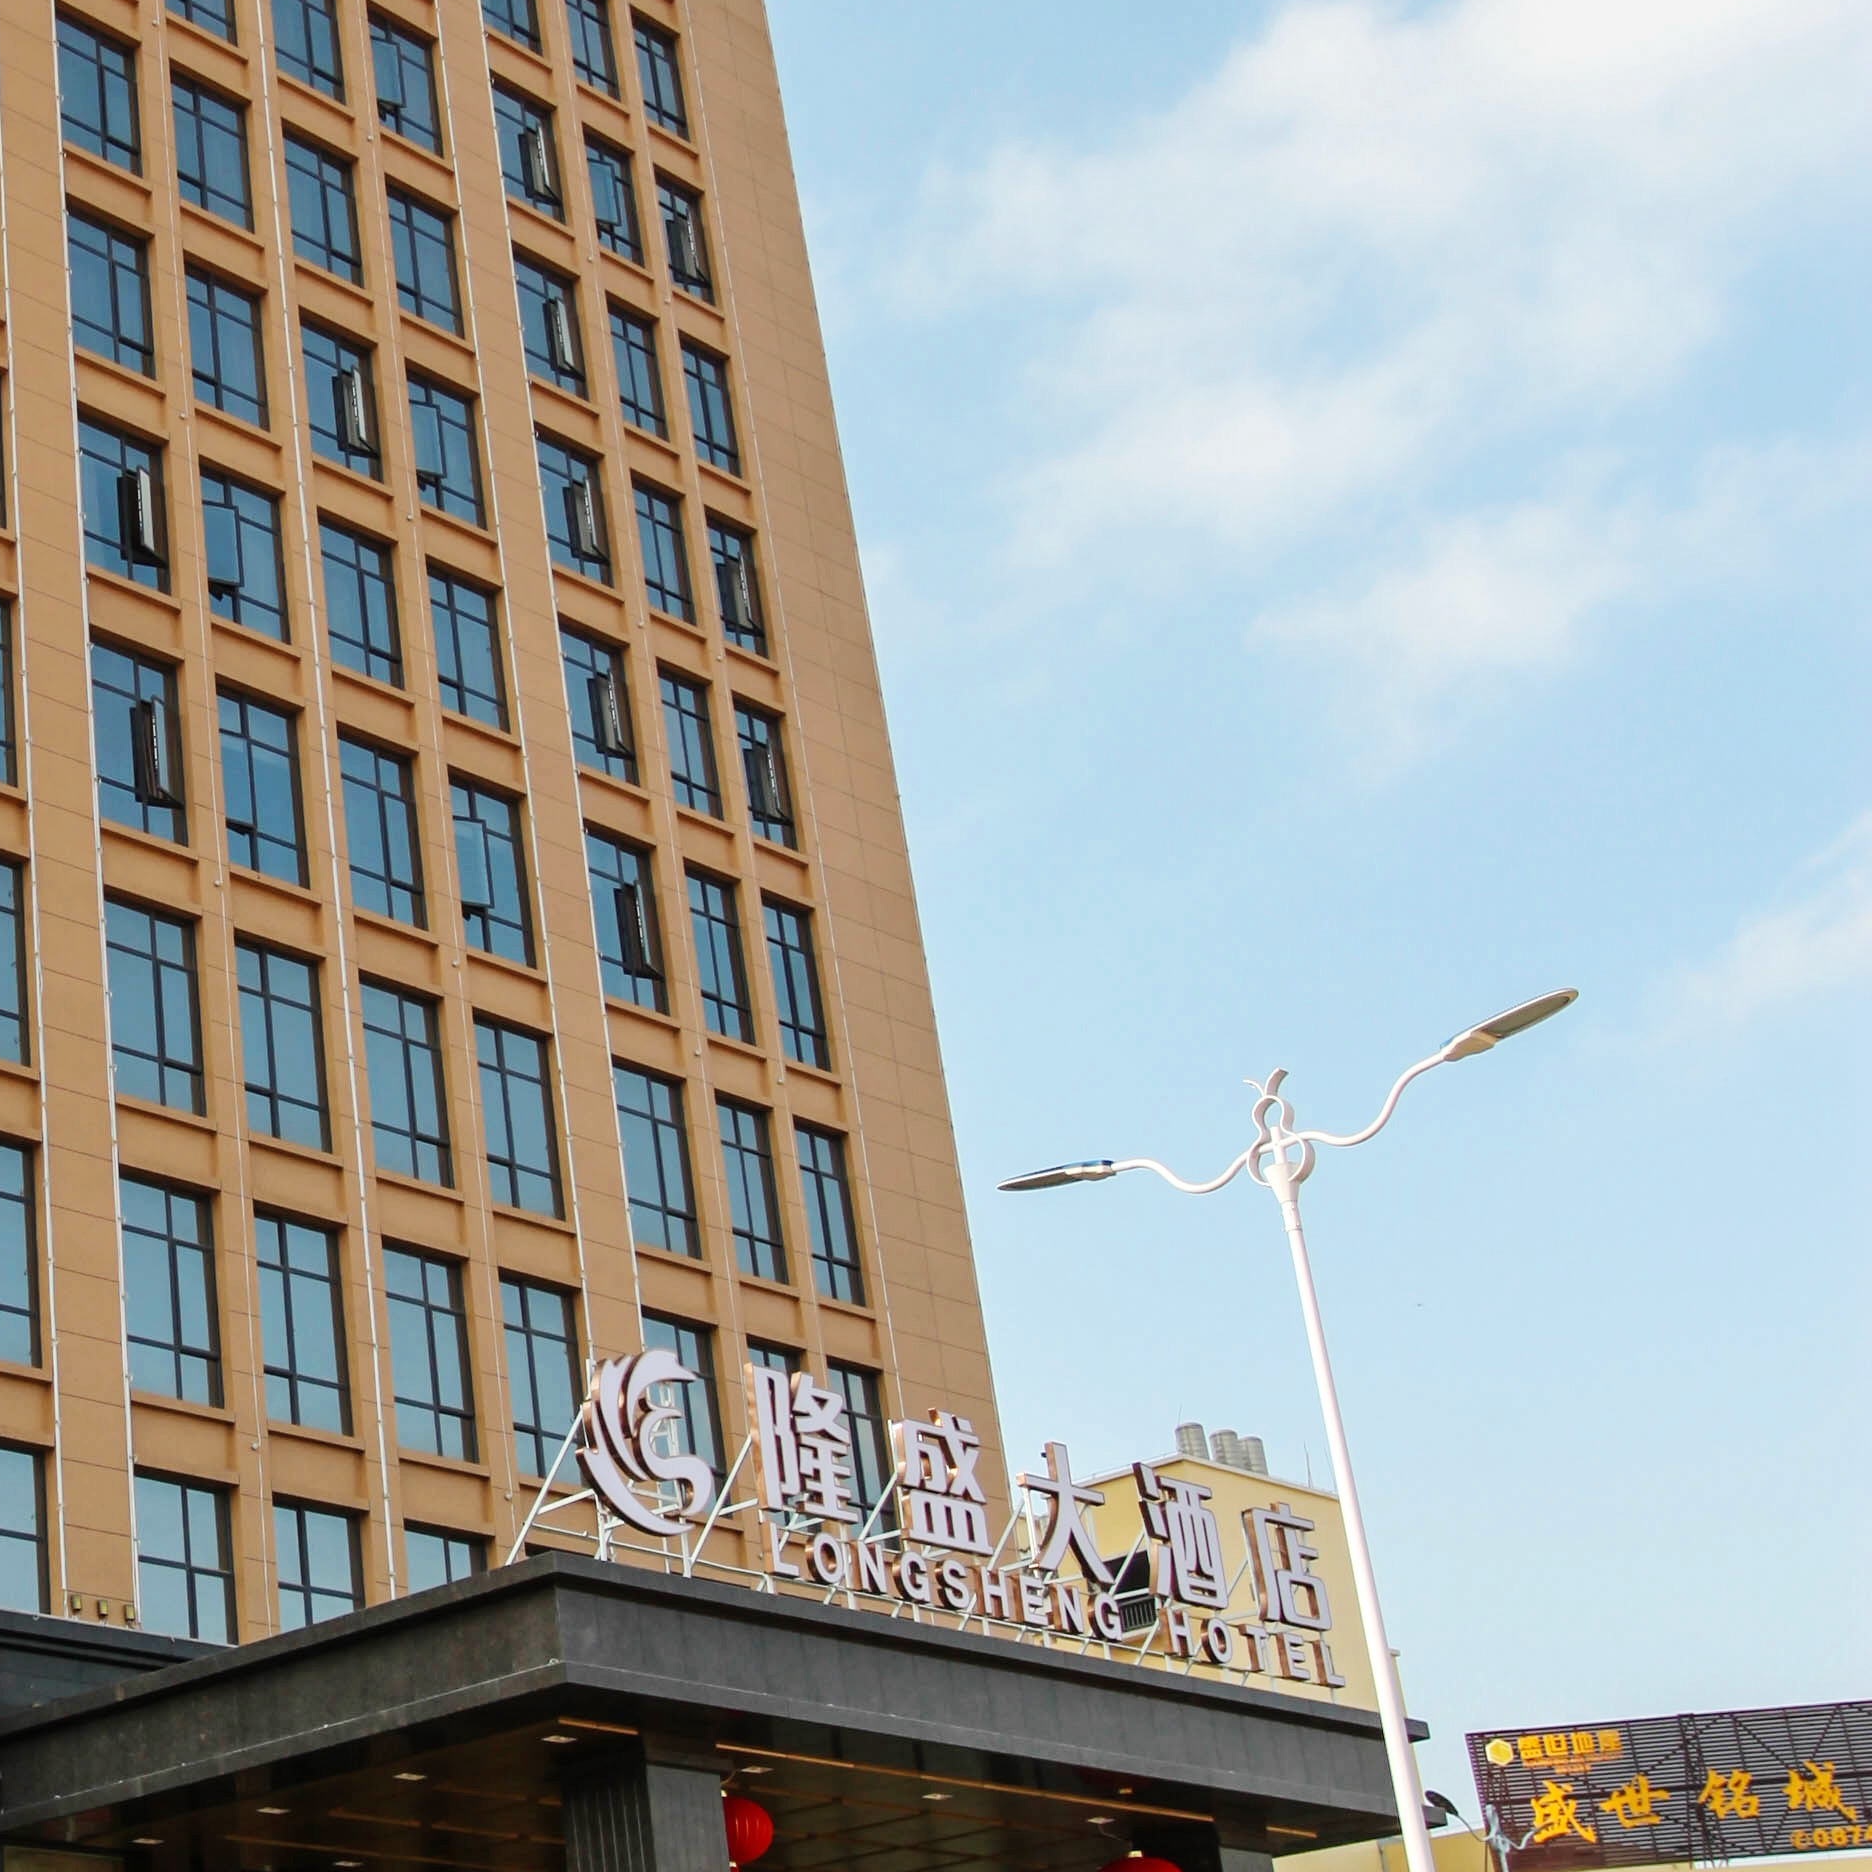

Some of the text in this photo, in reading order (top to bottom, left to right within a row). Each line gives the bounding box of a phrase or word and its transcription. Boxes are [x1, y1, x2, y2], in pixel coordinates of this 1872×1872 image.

[743, 1359, 1334, 1632] 隆盛大酒店
[764, 1524, 1347, 1690] LONGSHENG HOTEL
[1530, 1760, 1857, 1844] 盛世铭城
